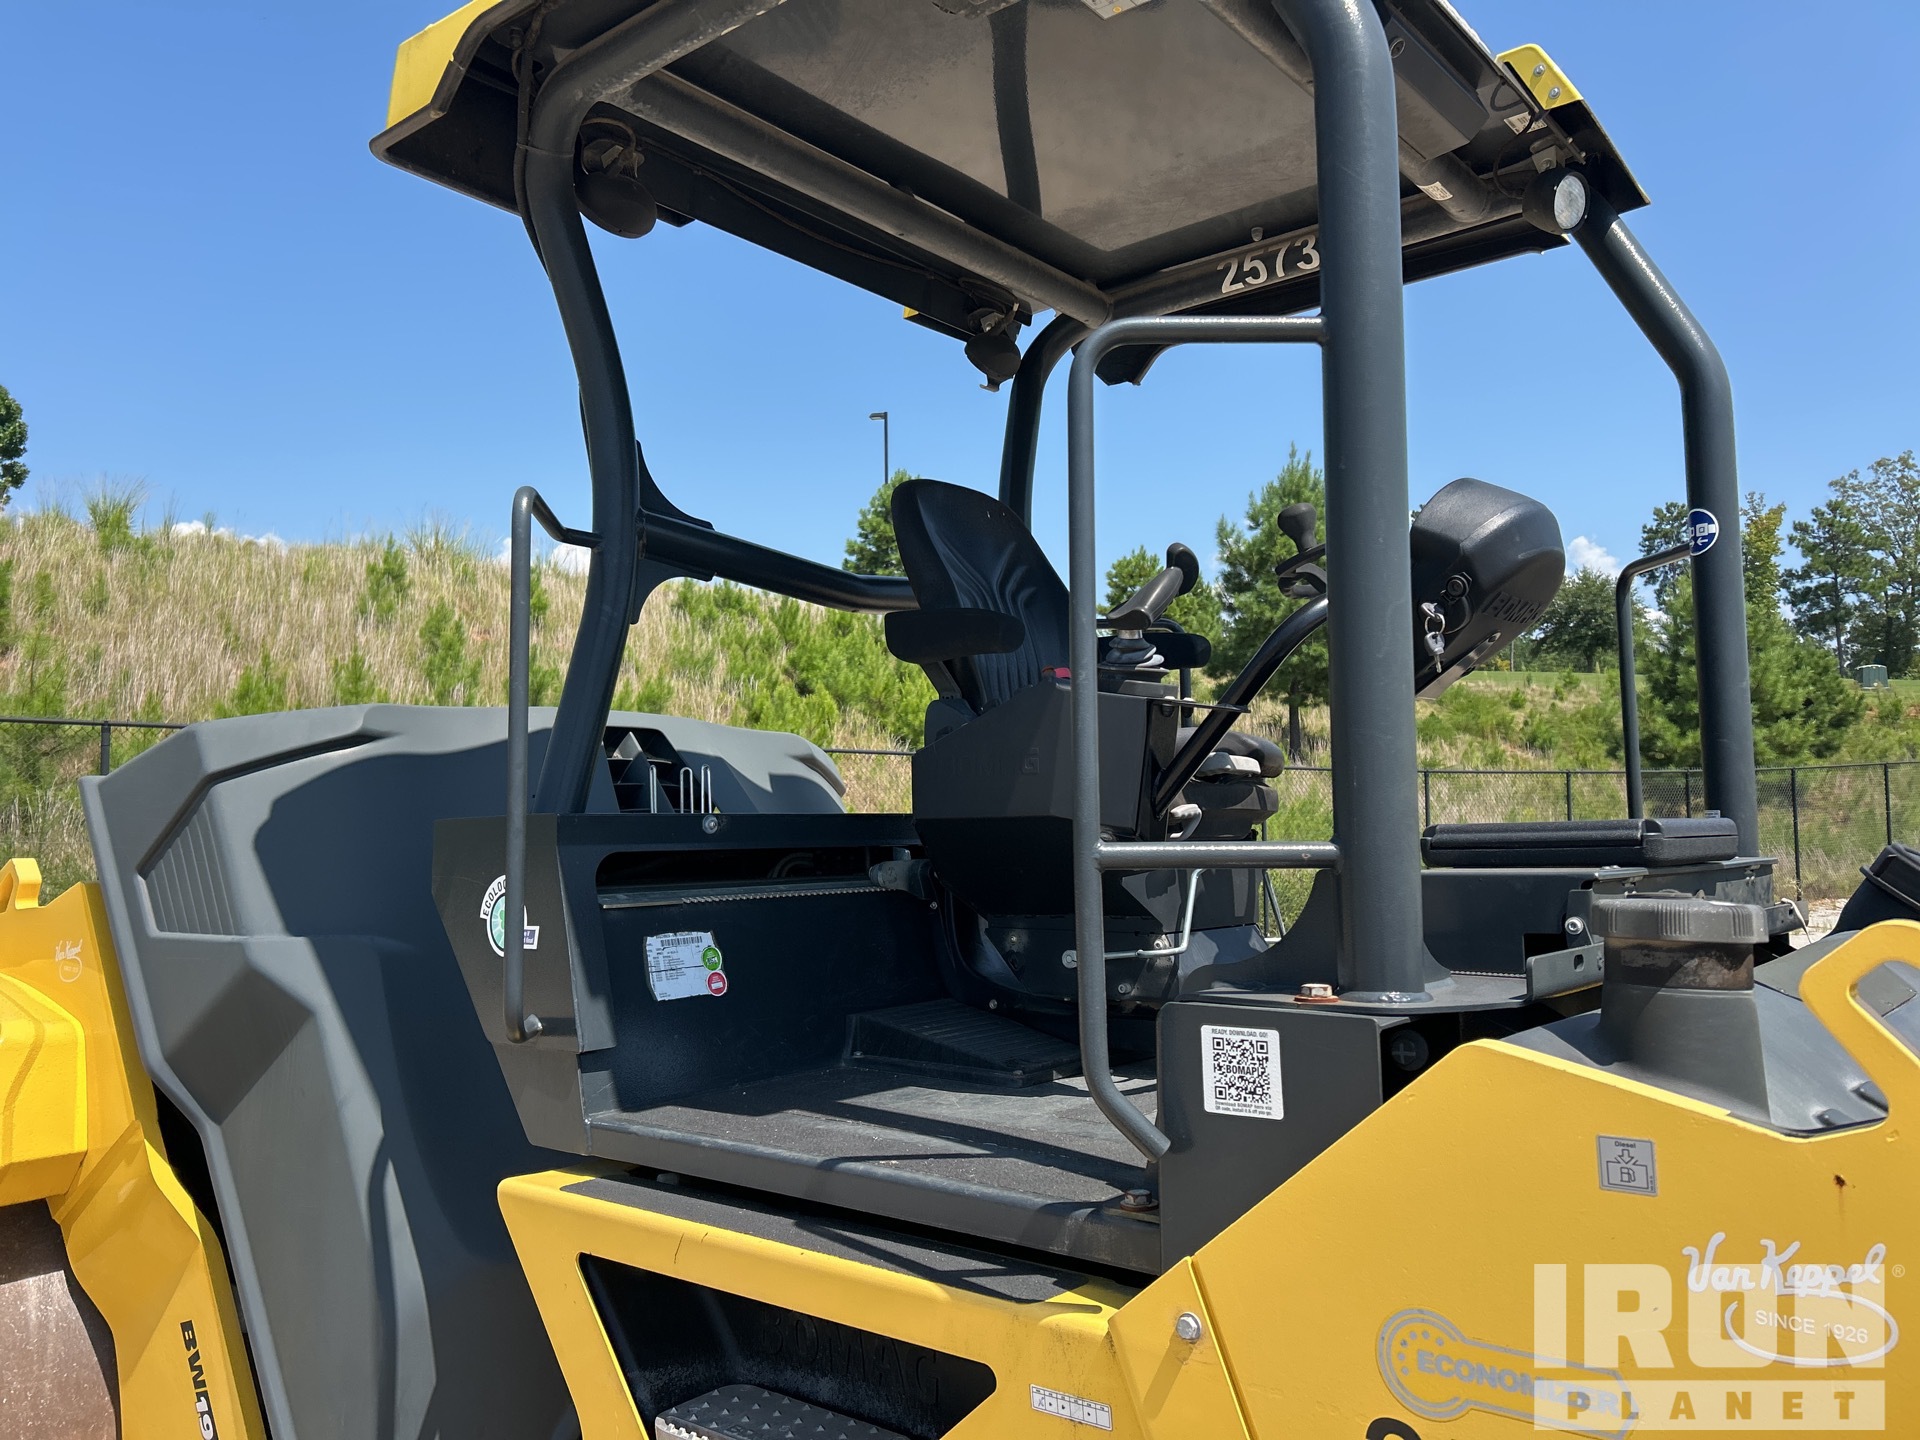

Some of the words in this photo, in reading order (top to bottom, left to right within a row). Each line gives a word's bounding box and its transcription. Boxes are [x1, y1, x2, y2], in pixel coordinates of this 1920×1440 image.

[1217, 234, 1320, 294] 2573
[1226, 1065, 1257, 1076] BOMAP
[1614, 1140, 1636, 1148] Diesel
[1682, 1231, 1755, 1293] Van
[1759, 1238, 1887, 1297] Keppel
[1754, 1309, 1816, 1335] SINCE
[1823, 1322, 1869, 1344] 1926
[1416, 1349, 1622, 1418] ECONOMIZER
